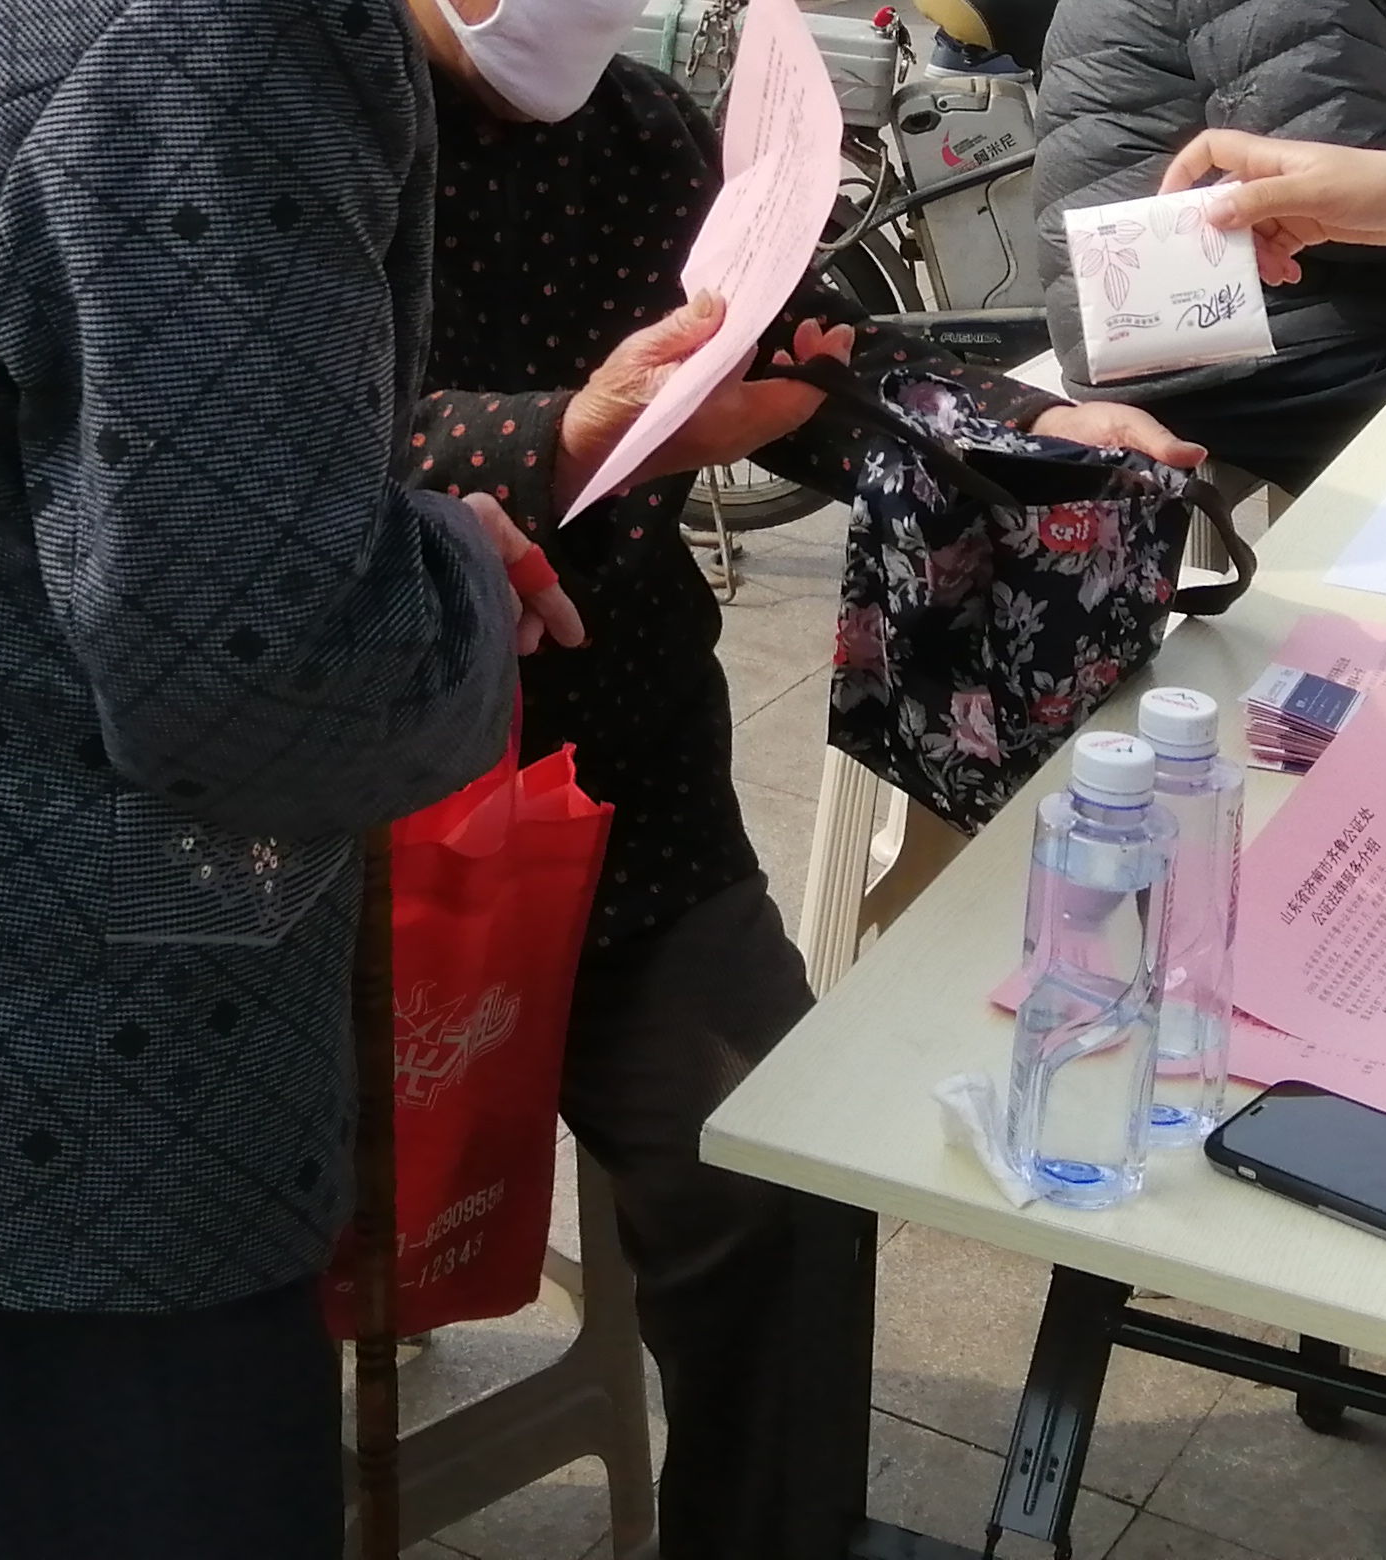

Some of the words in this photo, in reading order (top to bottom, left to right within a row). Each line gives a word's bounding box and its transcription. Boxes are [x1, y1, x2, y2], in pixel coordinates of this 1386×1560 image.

[973, 132, 1017, 166] 阿米尼
[1280, 806, 1375, 926] 山东省济南市齐鲁公证处
[1311, 836, 1382, 926] 公证法律服务介绍
